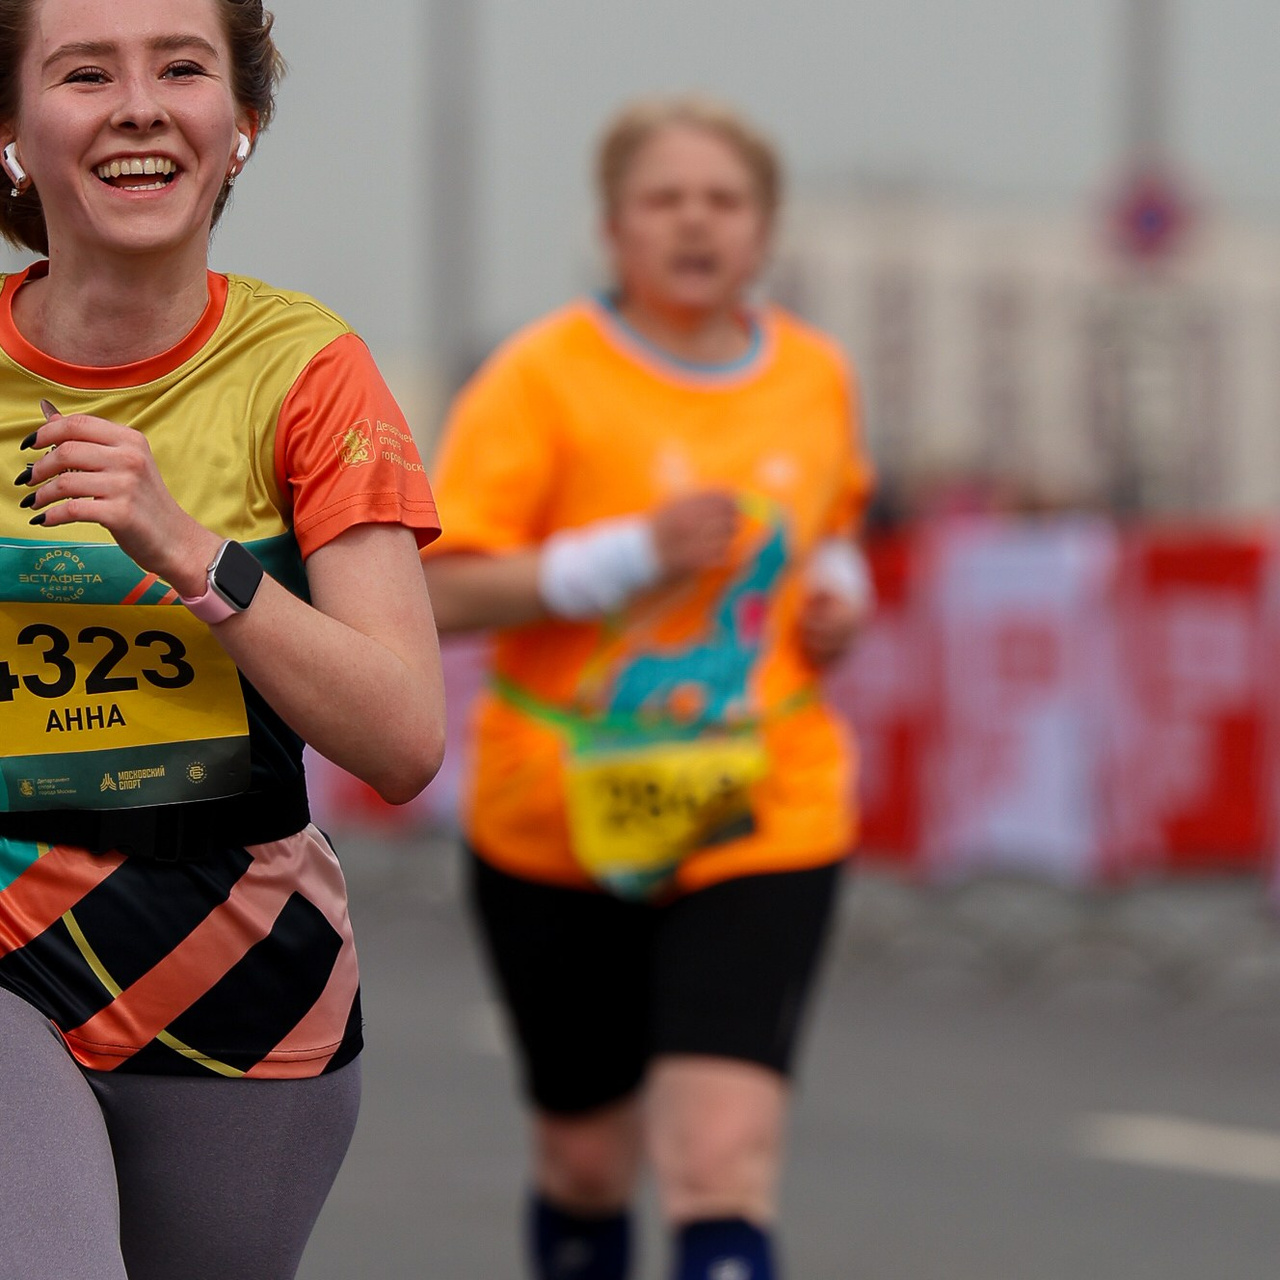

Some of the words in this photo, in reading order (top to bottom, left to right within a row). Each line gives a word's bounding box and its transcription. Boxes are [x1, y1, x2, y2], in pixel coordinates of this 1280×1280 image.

[34, 549, 85, 571] САДОВОЕ
[19, 573, 103, 584] ЭСТАФЕТА
[40, 586, 84, 602] КОЛЬЦО
[45, 703, 126, 732] АННА
[118, 765, 165, 780] МОСКОВСКИЙ
[119, 779, 141, 790] СПОРТ
